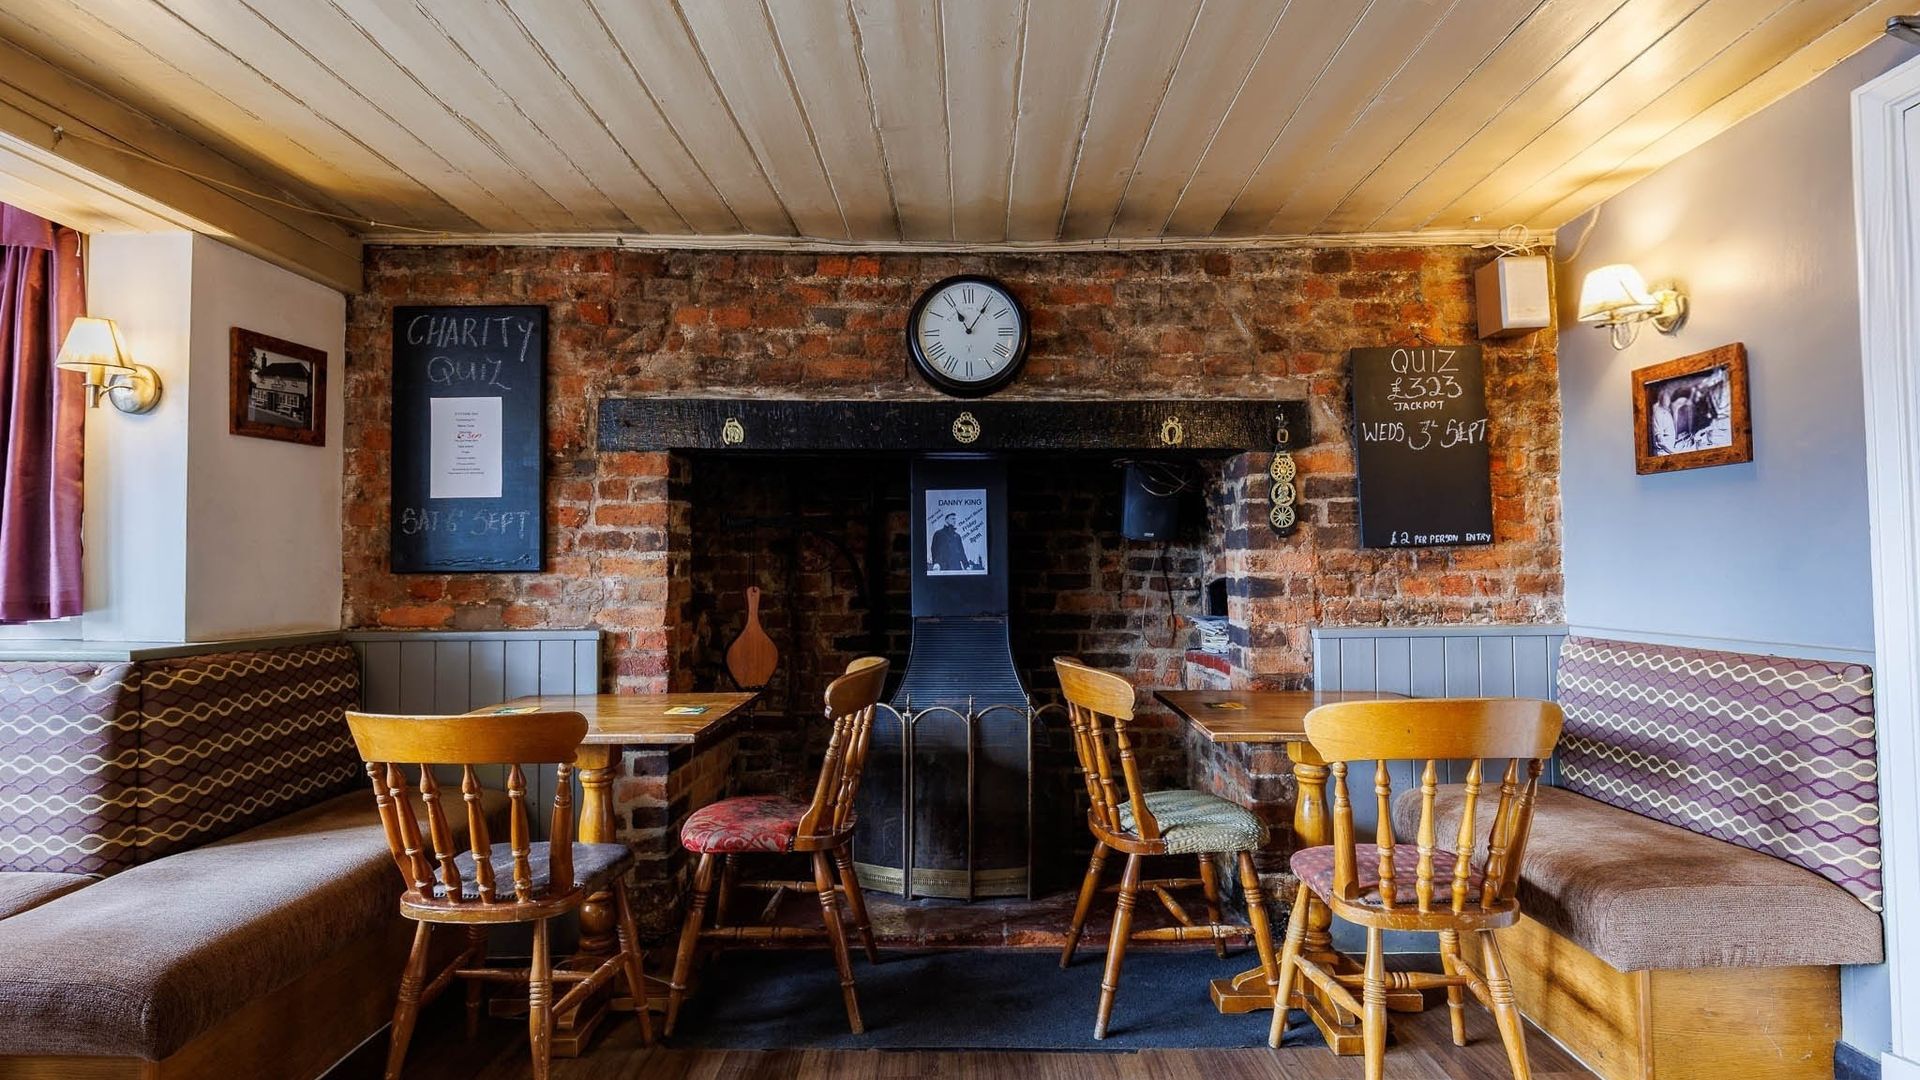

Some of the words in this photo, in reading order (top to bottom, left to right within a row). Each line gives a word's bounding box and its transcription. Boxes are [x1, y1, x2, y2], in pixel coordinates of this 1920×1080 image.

[407, 315, 534, 362] CHARITY
[427, 356, 512, 390] QUIZ
[1391, 348, 1460, 375] QUIZ
[1387, 375, 1463, 400] £323
[1393, 400, 1445, 412] JACKPOT
[1362, 421, 1405, 442] WEDS
[1440, 418, 1488, 448] SEPT
[938, 499, 963, 507] DANNY
[964, 498, 982, 506] KING
[401, 507, 440, 535] SAT
[470, 508, 531, 540] SEPT
[1414, 534, 1427, 545] PER
[1429, 534, 1459, 544] PERSON
[1465, 532, 1491, 542] ENTRY
